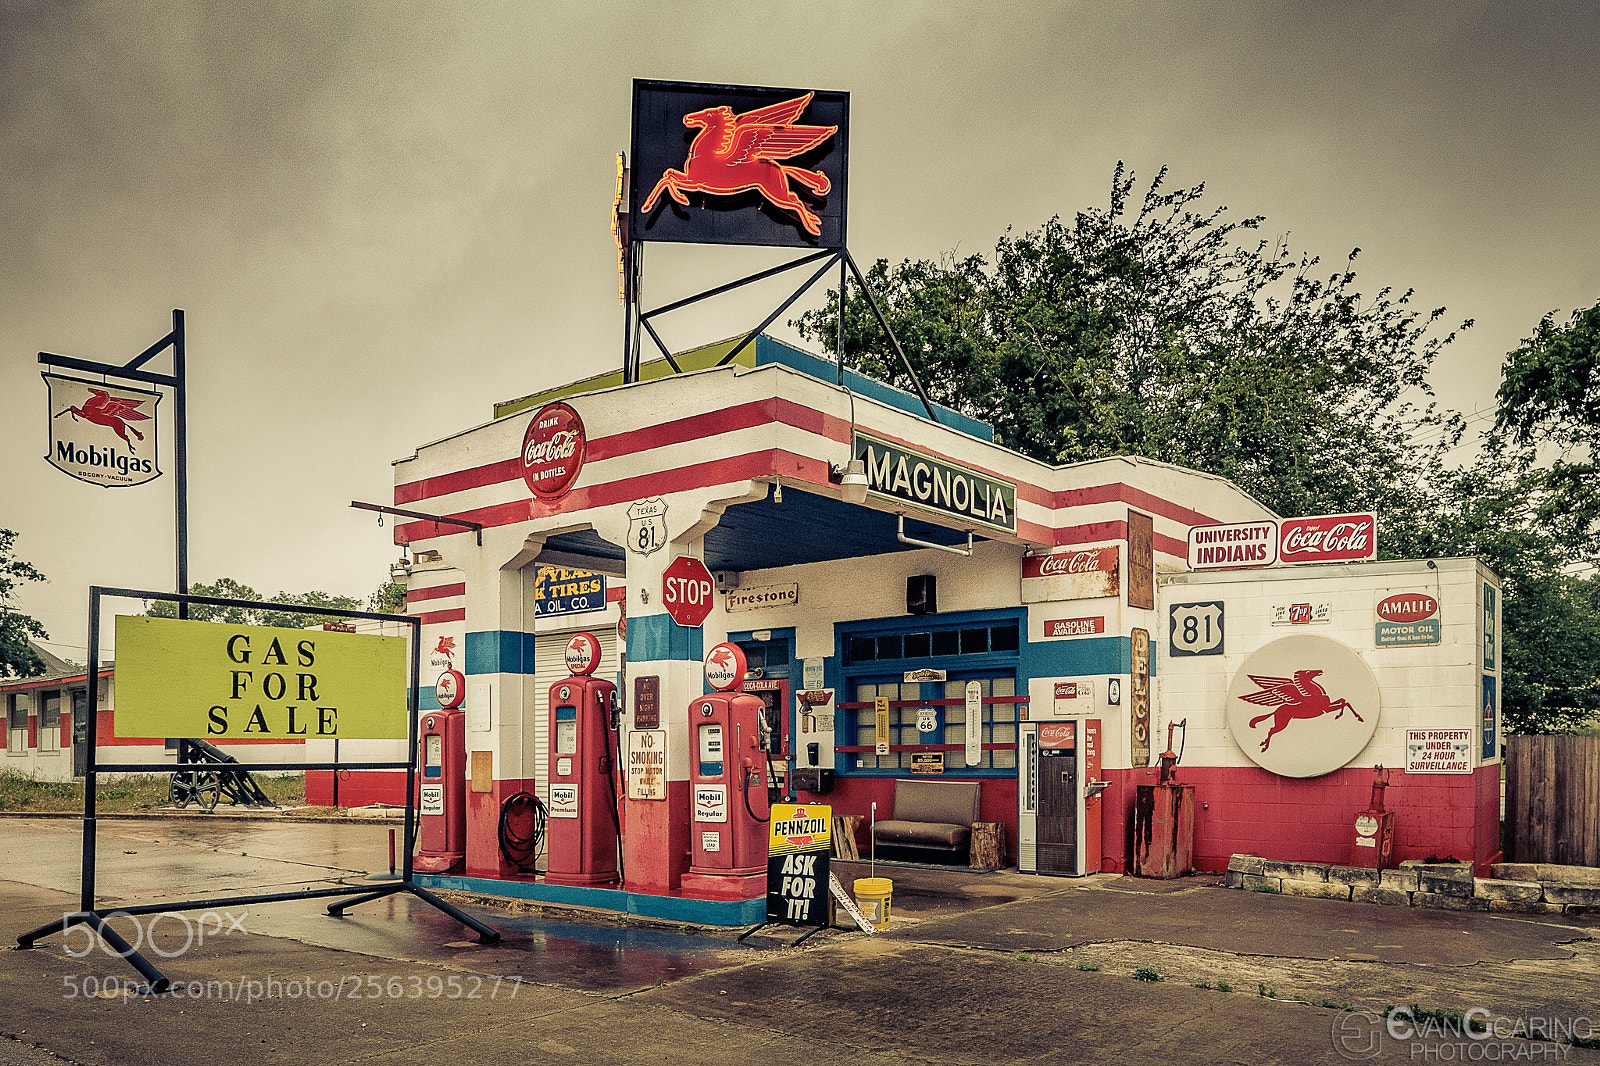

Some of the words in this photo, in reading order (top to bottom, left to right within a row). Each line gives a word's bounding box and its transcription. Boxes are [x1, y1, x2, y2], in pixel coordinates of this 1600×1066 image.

[539, 417, 558, 429] DRINK
[525, 430, 579, 467] Coca-Cola
[57, 440, 152, 476] Mobilgas
[78, 471, 133, 482] SOCONY-VACUUM
[532, 473, 539, 481] IN
[540, 467, 565, 480] BOTTLES
[867, 445, 1008, 524] MAGNOLIA
[637, 507, 658, 515] TEXAS
[638, 526, 655, 549] 81
[1195, 526, 1270, 544] UNIVERSITY
[1282, 521, 1371, 554] Coca-Cola
[1197, 544, 1267, 564] INDIANS
[1040, 550, 1101, 576] Coca-Cola
[549, 578, 601, 598] TIRES
[665, 576, 711, 605] STOP
[547, 599, 566, 612] OIL
[571, 596, 590, 609] CO.
[728, 590, 795, 608] Firestone
[1381, 599, 1432, 615] AMALIE
[1052, 627, 1096, 636] AVAILABLE
[1054, 620, 1095, 630] GASOLINE
[1182, 614, 1212, 645] 81
[1381, 626, 1415, 635] MOTOR
[1417, 625, 1434, 633] OIL
[227, 635, 316, 668] GAS
[566, 656, 591, 664] Mobilgas
[707, 671, 735, 681] Mobilgas
[229, 671, 320, 700] FOR
[207, 705, 338, 736] SALE
[920, 721, 933, 730] 66
[1042, 726, 1071, 738] Coca-Cola
[1409, 732, 1426, 740] THIS
[1428, 732, 1469, 741] PROPERTY
[641, 734, 653, 748] NO
[1425, 742, 1452, 750] UNDER
[631, 751, 663, 765] SMOKING
[1434, 752, 1455, 760] HOUR
[1409, 762, 1467, 770] SURVEILLANCE
[554, 791, 573, 799] Mobil
[699, 793, 721, 801] Mobil
[697, 809, 722, 818] Regular
[774, 818, 827, 837] PENNZOIL
[781, 855, 817, 876] ASK
[781, 877, 816, 899] FOR
[787, 900, 809, 920] IT!
